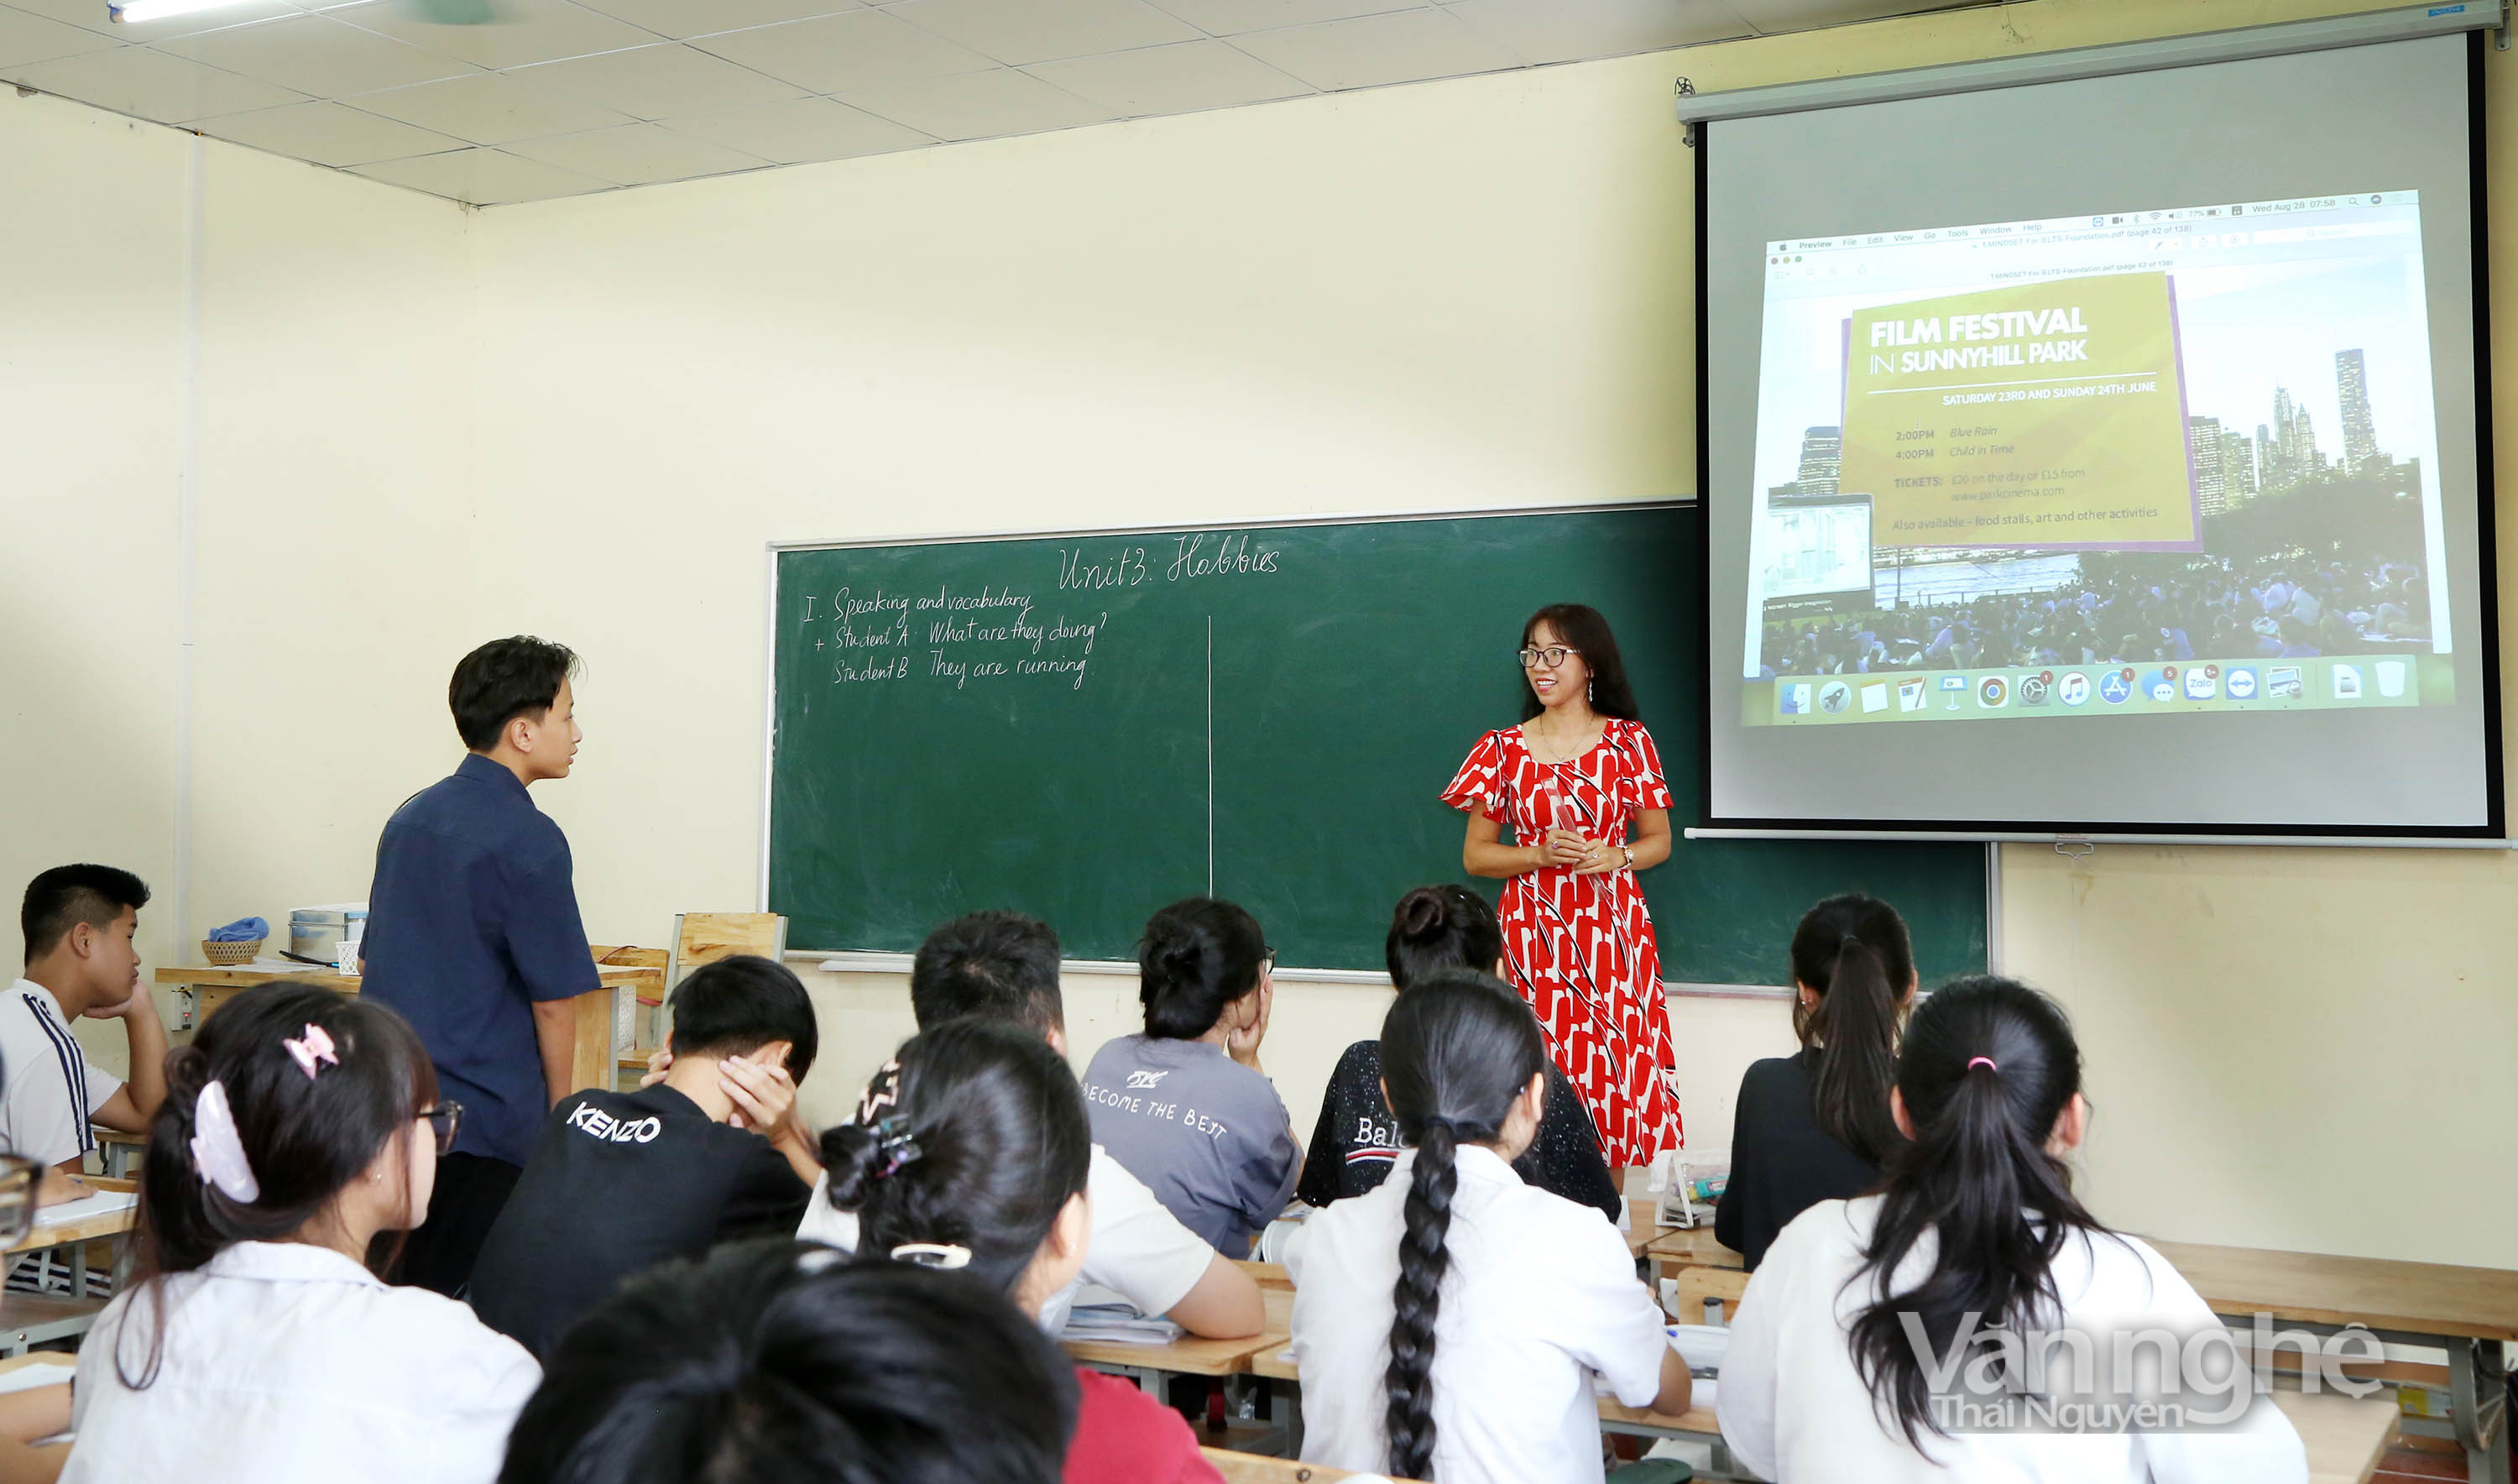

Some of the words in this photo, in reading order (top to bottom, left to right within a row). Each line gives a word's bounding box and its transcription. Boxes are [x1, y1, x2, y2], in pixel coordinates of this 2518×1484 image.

[2188, 209, 2204, 218] 77%
[2253, 203, 2272, 214] Wed
[2275, 201, 2291, 213] Aug
[2293, 201, 2305, 210] 28
[2311, 198, 2336, 209] 07:58
[1799, 239, 1832, 249] Preview
[1842, 238, 1857, 247] File
[1868, 235, 1883, 245] Edit
[1894, 233, 1914, 243] View
[1924, 231, 1936, 240] Go
[1947, 229, 1968, 238] Tools
[1980, 225, 2012, 235] Window
[2023, 222, 2043, 233] Help
[2127, 227, 2150, 239] (page
[2151, 227, 2162, 236] 42
[2164, 226, 2172, 234] of
[2174, 224, 2192, 234] 138)
[1870, 318, 1941, 347] FILM
[1949, 307, 2088, 342] FESTIVAL
[1870, 353, 1895, 375] IN
[1901, 343, 2024, 374] SUNNYHILL
[2029, 339, 2088, 364] PARK
[1942, 391, 1997, 406] SATURDAY
[1998, 389, 2026, 403] 23RD
[2028, 388, 2051, 400] AND
[2053, 384, 2096, 400] SUNDAY
[2097, 383, 2125, 396] 24TH
[2128, 381, 2157, 395] JUNE
[1895, 430, 1935, 442] 2:00PM
[1950, 426, 1972, 438] Blue
[1974, 426, 1998, 436] Rain
[1895, 448, 1935, 461] 4:00PM
[1950, 445, 1975, 457] Child
[1977, 445, 1987, 455] in
[1989, 443, 2014, 454] Time
[1894, 477, 1943, 489] TICKETS:
[1972, 474, 1986, 484] on
[1988, 472, 2004, 484] the
[2005, 471, 2027, 486] day
[2027, 472, 2038, 482] or
[2041, 468, 2059, 481] £15
[2061, 468, 2086, 478] from
[1894, 520, 1915, 530] Also
[2002, 512, 2033, 526] stalls,
[2035, 511, 2052, 524] art
[2054, 509, 2074, 522] and
[2077, 507, 2106, 520] other
[2109, 506, 2158, 520] activities
[1167, 533, 1280, 582] Hobbies
[834, 587, 911, 629] Speaking
[917, 585, 945, 610] and
[948, 586, 1034, 627] vocabulary
[835, 624, 891, 649] Student
[929, 615, 979, 645] What
[979, 626, 1007, 641] are
[1011, 621, 1042, 655] they
[834, 656, 895, 684] Student
[929, 648, 966, 689] They
[973, 661, 1007, 677] are
[2189, 677, 2212, 688] Zalo
[566, 1101, 661, 1143] KENZO
[1147, 1100, 1177, 1121] THE
